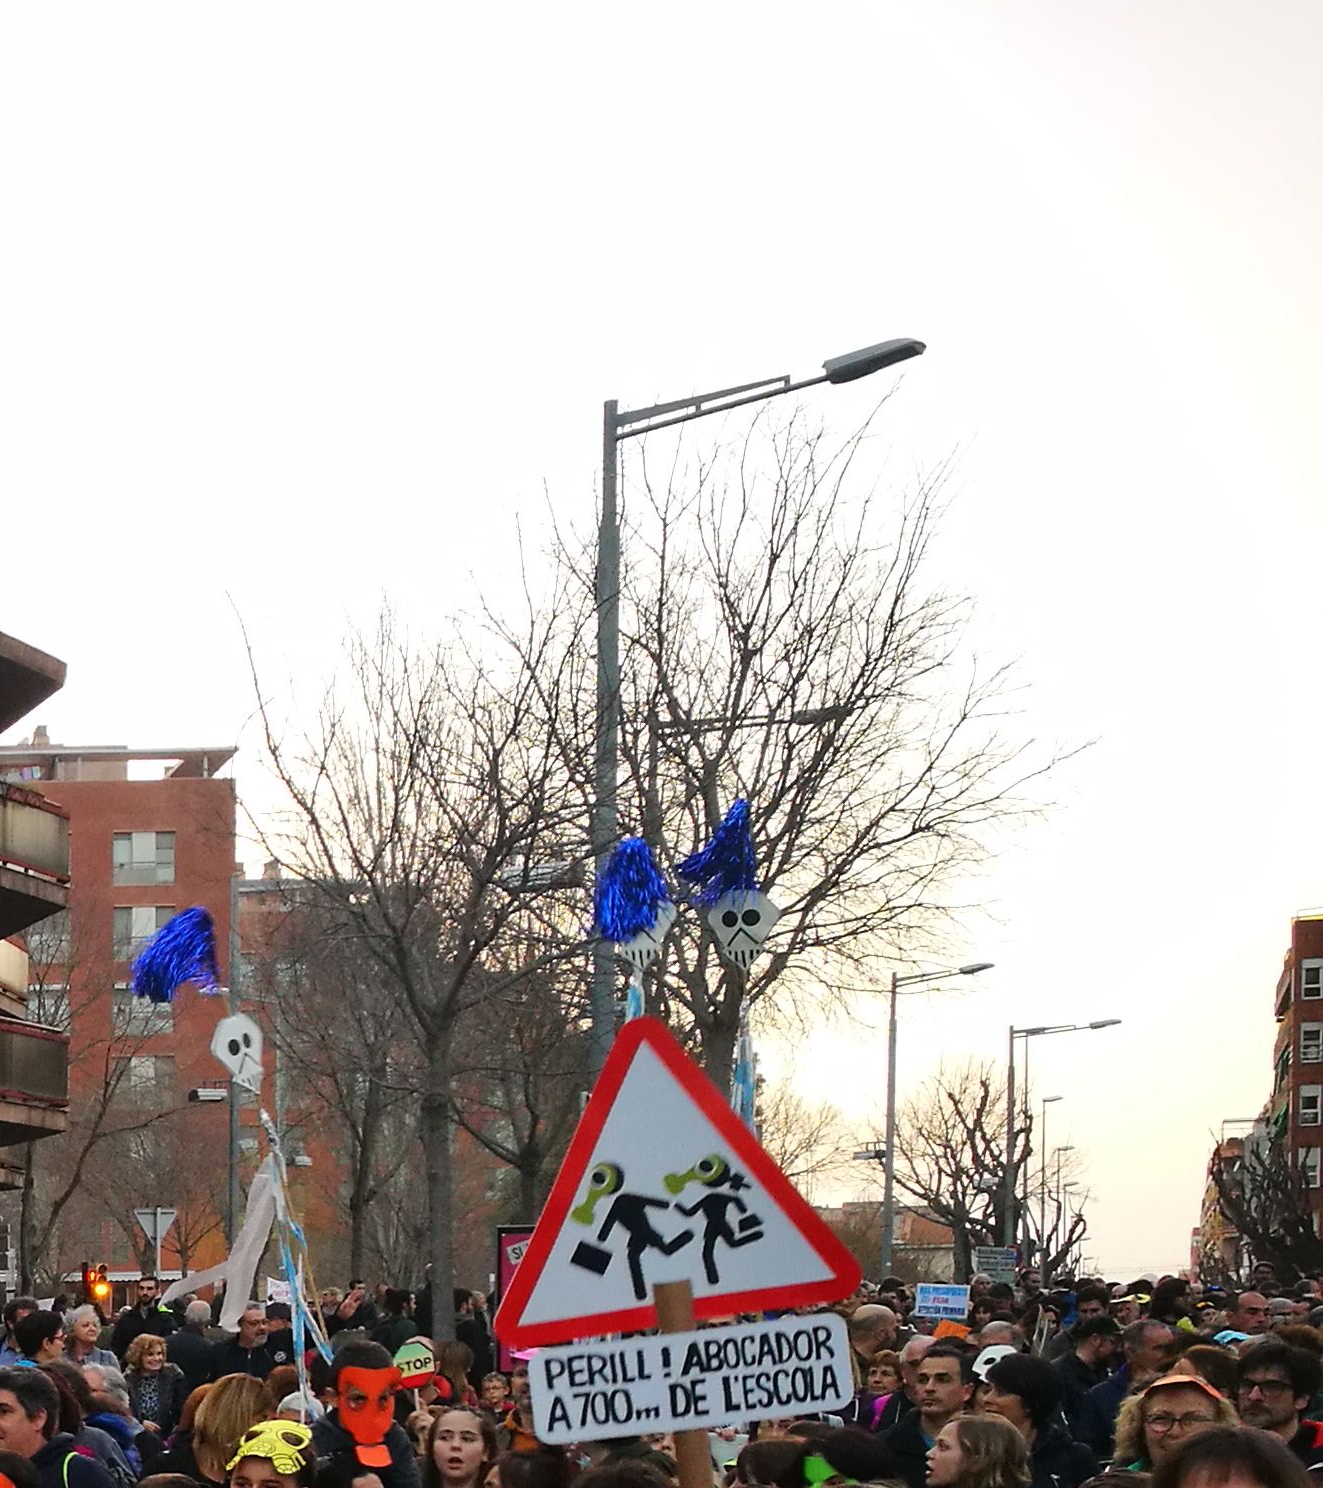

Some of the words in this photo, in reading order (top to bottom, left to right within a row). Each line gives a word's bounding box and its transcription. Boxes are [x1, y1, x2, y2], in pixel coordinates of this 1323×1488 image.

[544, 1350, 652, 1390] PERILL
[681, 1326, 835, 1377] ABOCADOR
[669, 1378, 710, 1419] DE
[721, 1364, 842, 1412] L'ESCOLA
